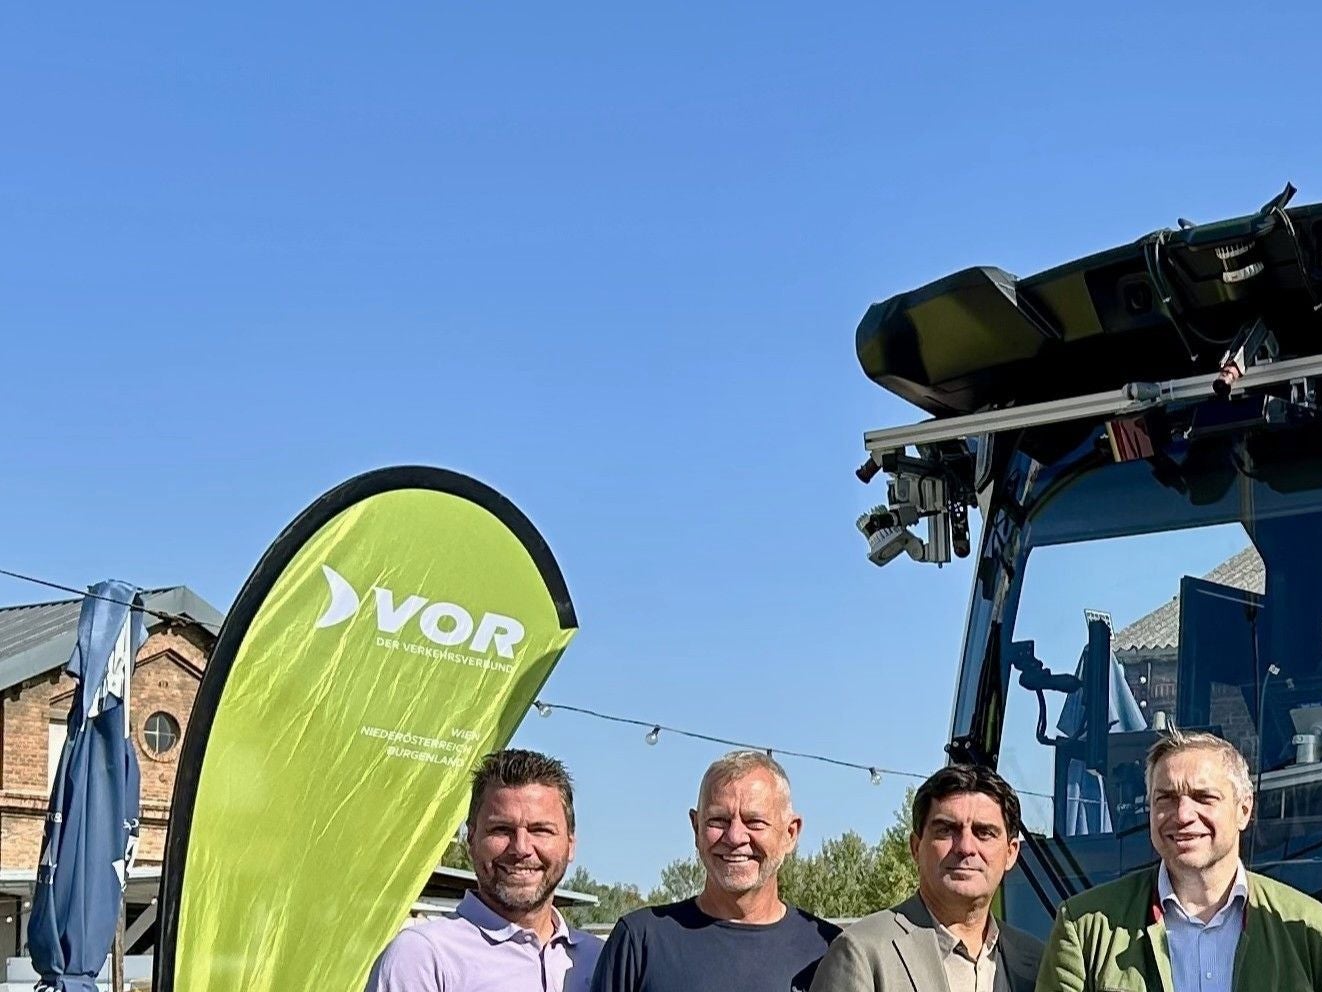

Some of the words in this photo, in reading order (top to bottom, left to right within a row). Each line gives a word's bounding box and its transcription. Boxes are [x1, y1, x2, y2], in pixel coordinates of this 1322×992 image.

[374, 587, 526, 659] VOR
[376, 636, 400, 650] DER
[402, 641, 514, 674] VERKEHRSVERBUND
[360, 725, 474, 754] NIEDERÖSTERREICH
[451, 727, 481, 742] WIEN
[386, 746, 465, 767] BURGENLAND
